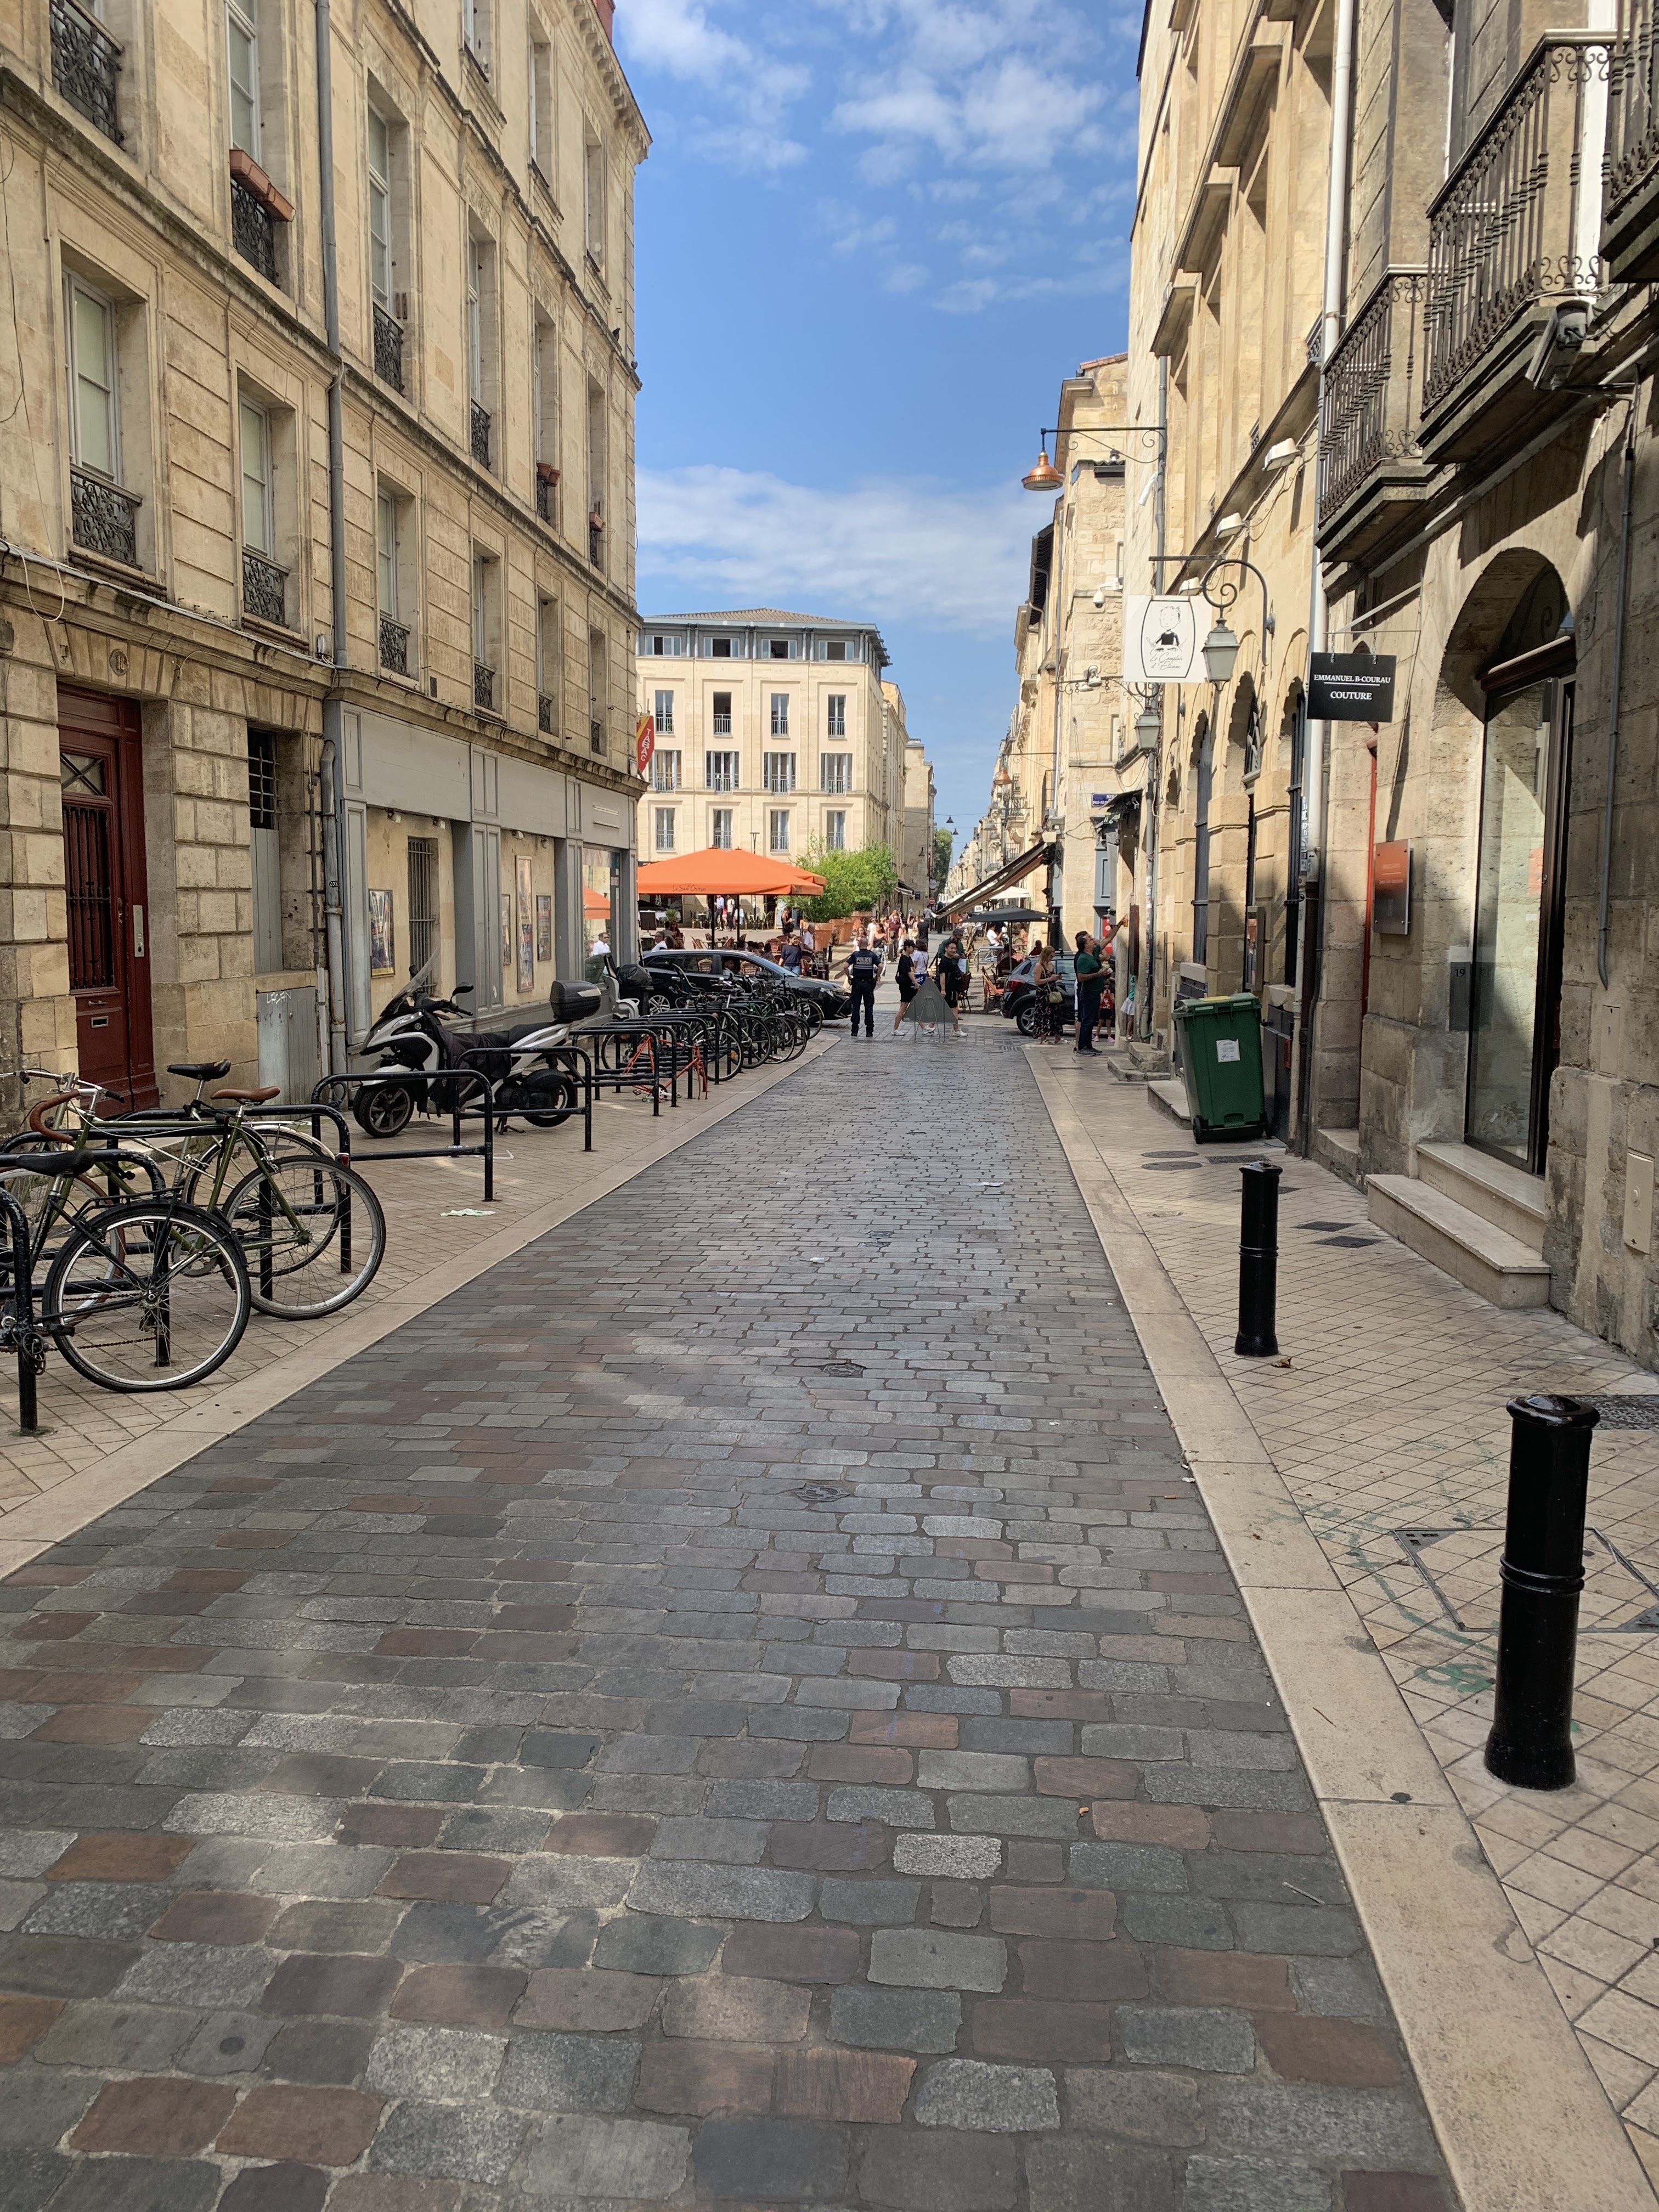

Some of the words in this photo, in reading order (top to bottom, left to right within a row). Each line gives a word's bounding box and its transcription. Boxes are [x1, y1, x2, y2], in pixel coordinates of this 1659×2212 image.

[1330, 691, 1372, 700] COUTURE
[640, 728, 651, 761] TABAC
[1455, 967, 1466, 977] 19
